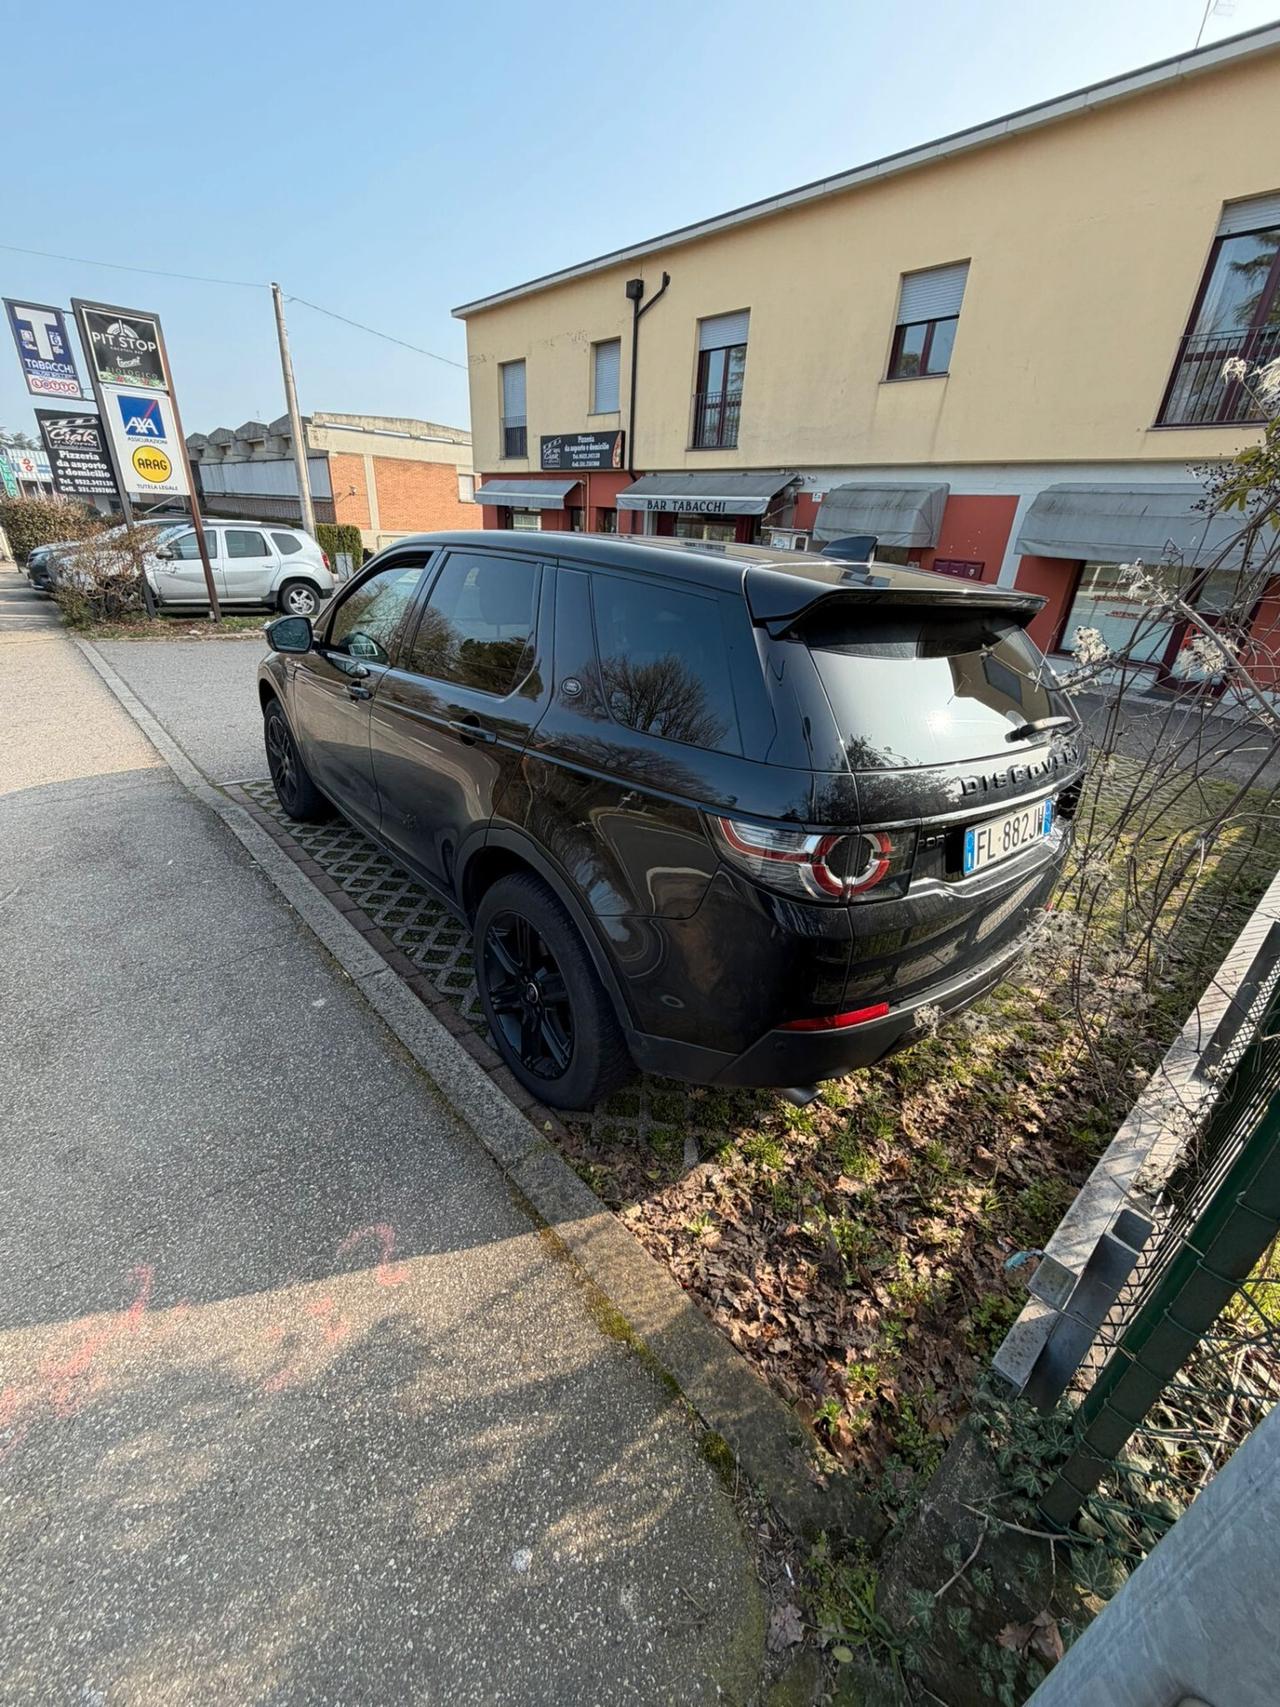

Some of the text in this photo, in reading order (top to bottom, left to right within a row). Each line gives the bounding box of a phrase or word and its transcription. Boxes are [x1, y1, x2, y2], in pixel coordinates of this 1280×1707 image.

[14, 306, 58, 360] T
[92, 331, 157, 352] PIT STOP
[25, 358, 74, 374] TABACCHI
[31, 378, 78, 393] LOTTO
[125, 416, 160, 435] AXA
[58, 450, 100, 460] Pizzeria
[56, 459, 107, 470] da asporto
[137, 458, 168, 471] ARAG
[65, 468, 110, 478] domicilio
[647, 500, 727, 512] BAR TABACCHI
[977, 828, 996, 866] FL
